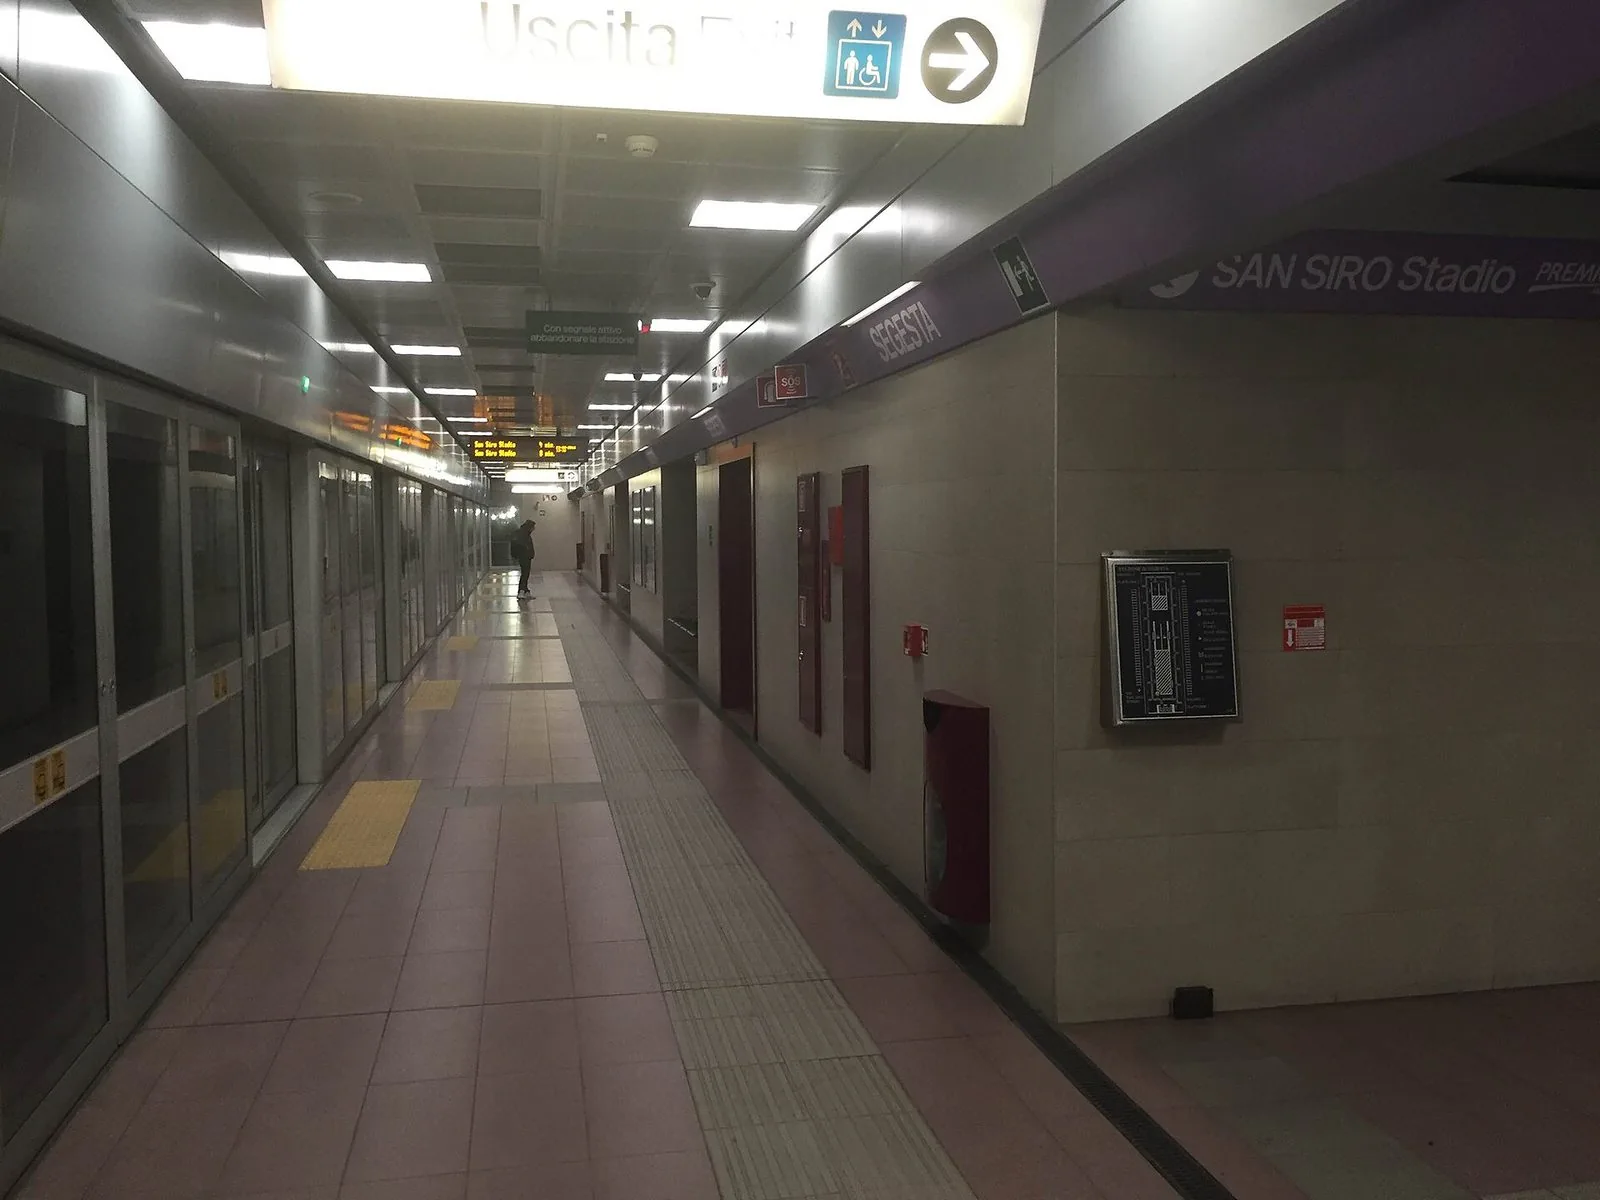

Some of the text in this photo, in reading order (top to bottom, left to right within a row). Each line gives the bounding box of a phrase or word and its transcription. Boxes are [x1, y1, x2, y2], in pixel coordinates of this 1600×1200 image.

[480, 1, 677, 66] Uscita
[1212, 253, 1517, 294] SAN SIRO Stadio
[543, 323, 562, 333] Con
[869, 300, 943, 362] SEGESTA
[781, 376, 801, 388] SOS
